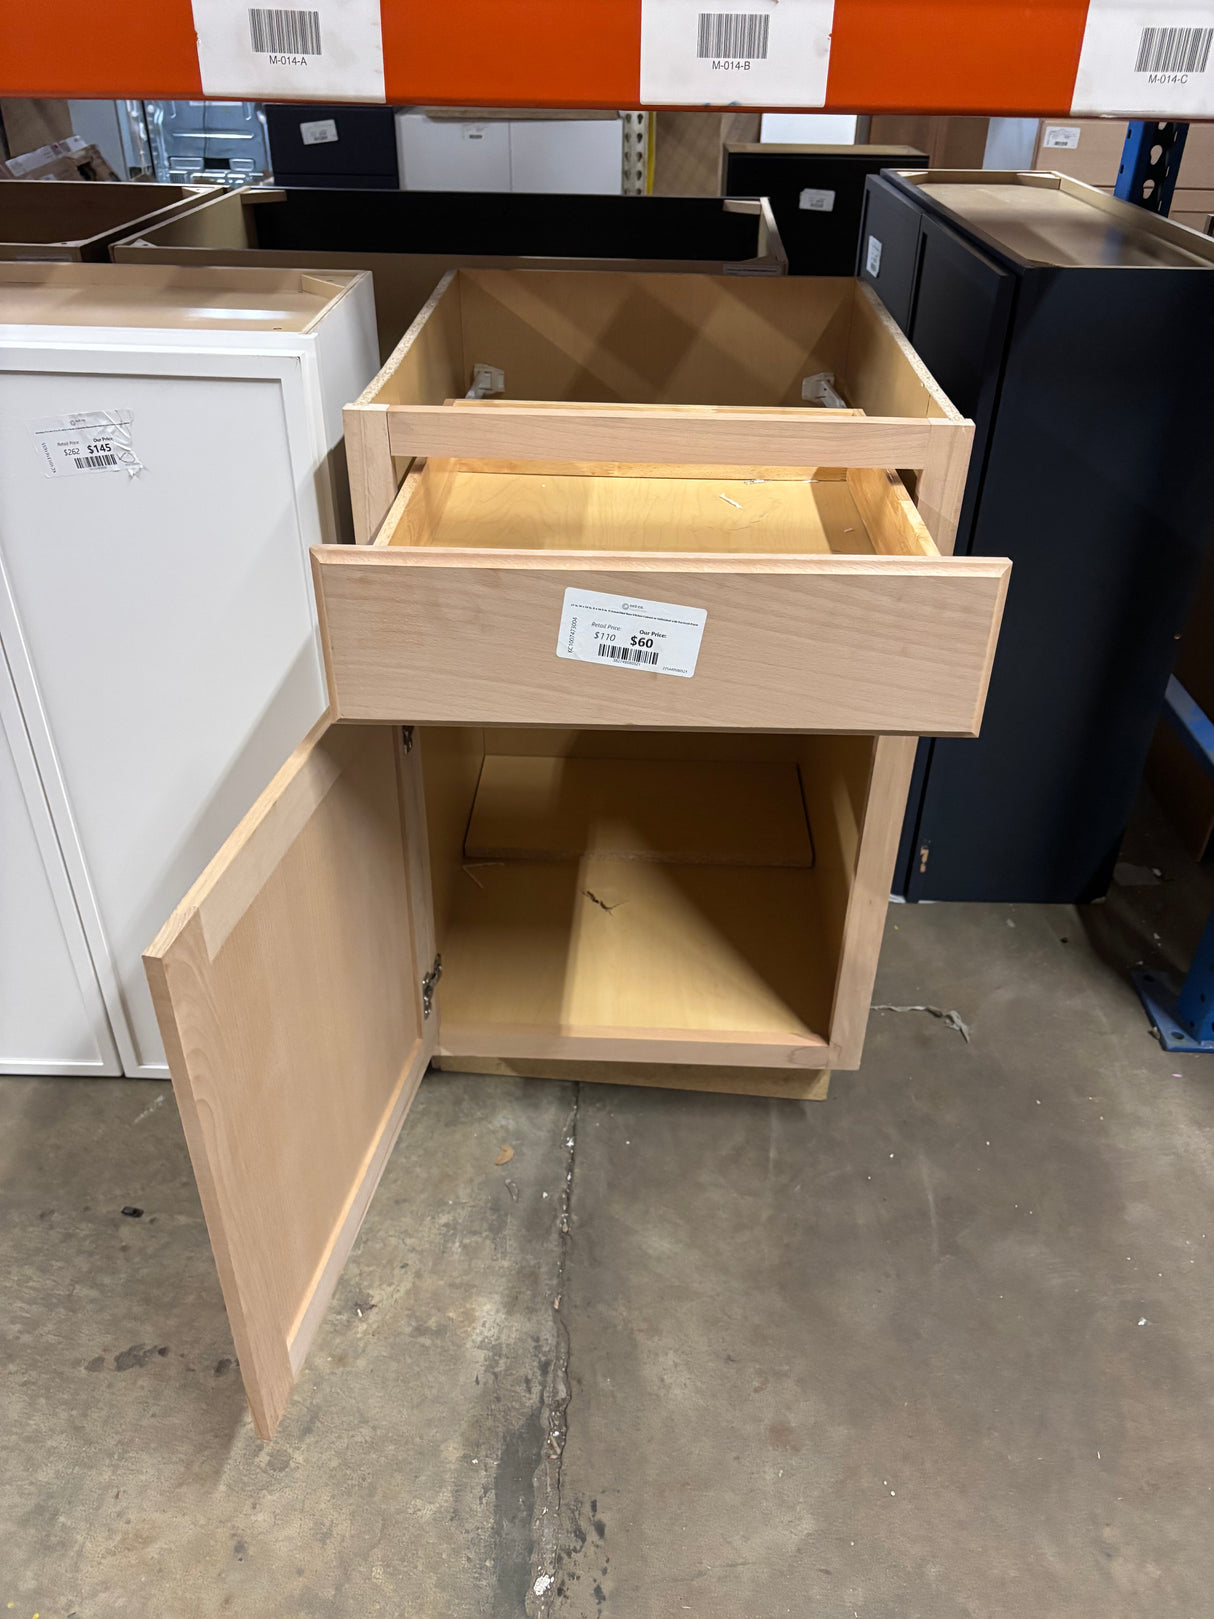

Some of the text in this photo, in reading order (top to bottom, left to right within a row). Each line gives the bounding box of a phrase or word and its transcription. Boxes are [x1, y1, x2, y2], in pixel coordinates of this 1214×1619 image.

[269, 55, 307, 66] M-014-A
[712, 60, 751, 70] M-014-B
[1148, 74, 1188, 84] M-014-C
[64, 448, 80, 456] $262
[87, 443, 112, 454] $145
[591, 621, 621, 632] Retail Price:
[594, 631, 616, 642] $110
[650, 630, 667, 639] Price:
[630, 635, 654, 649] $60
